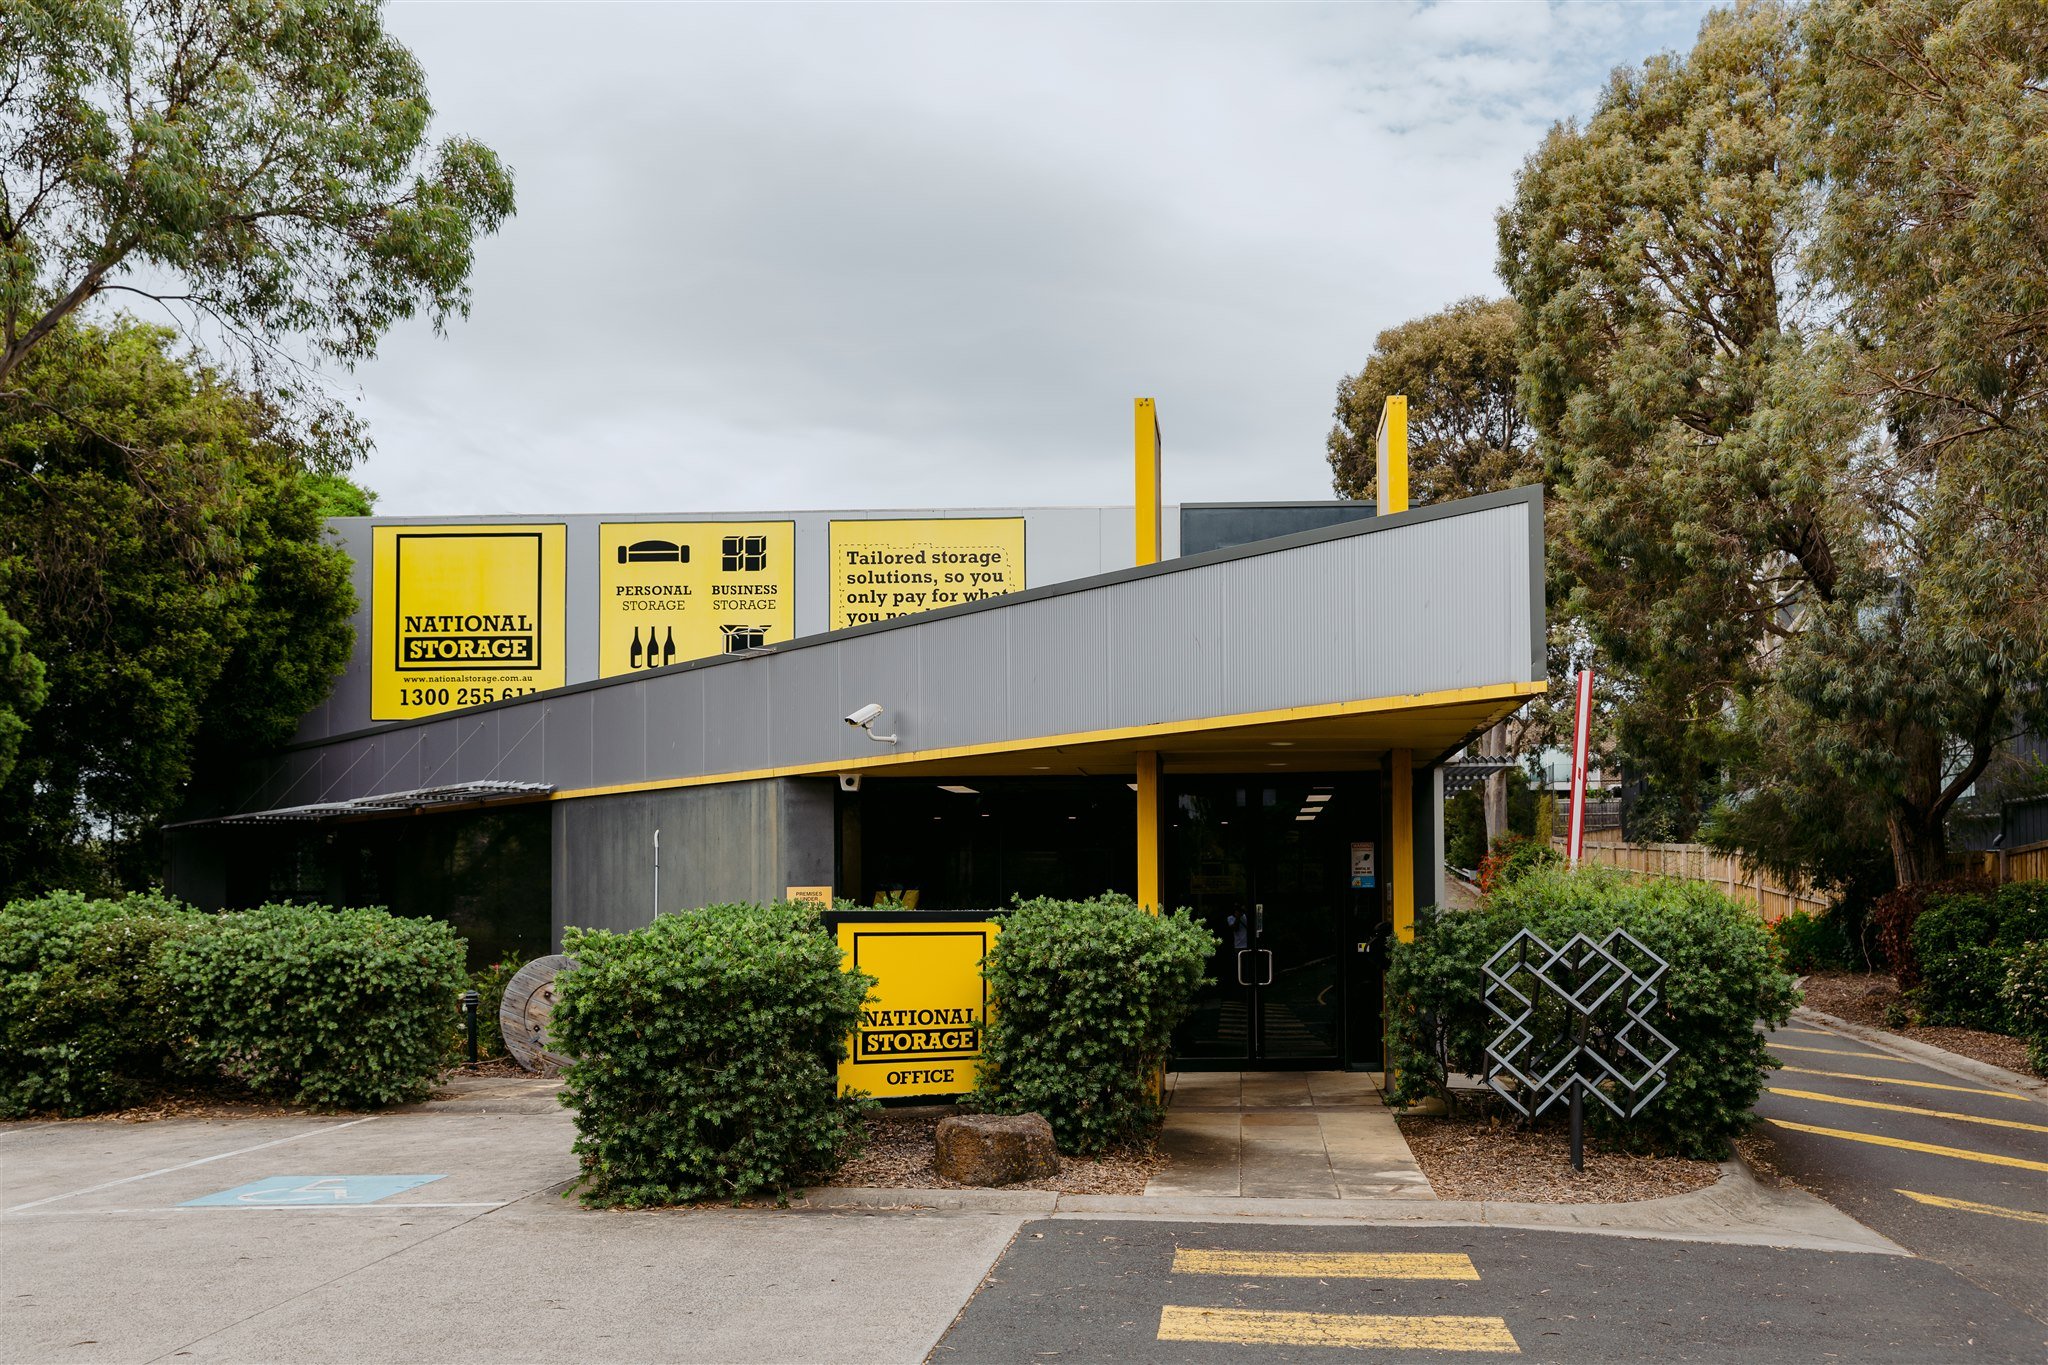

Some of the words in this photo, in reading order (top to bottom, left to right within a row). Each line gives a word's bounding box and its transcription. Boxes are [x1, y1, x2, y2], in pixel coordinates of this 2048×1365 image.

[846, 550, 926, 565] Tailored
[931, 550, 1002, 567] storage
[846, 570, 939, 586] solutions,
[944, 573, 965, 583] so
[970, 572, 1004, 586] you
[616, 585, 692, 596] PERSONAL
[711, 584, 778, 595] BUSINESS
[846, 589, 888, 607] only
[893, 591, 926, 607] pay
[931, 588, 958, 603] for
[622, 599, 686, 611] STORAGE
[713, 599, 777, 610] STORAGE
[404, 614, 533, 633] NATIONAL
[846, 612, 880, 626] you
[409, 639, 527, 659] STORAGE
[403, 675, 533, 684] www.nationalstorage.com.au
[400, 688, 449, 706] 1300
[457, 688, 494, 705] 255
[867, 1031, 973, 1052] STORAGE
[886, 1069, 954, 1085] OFFICE
